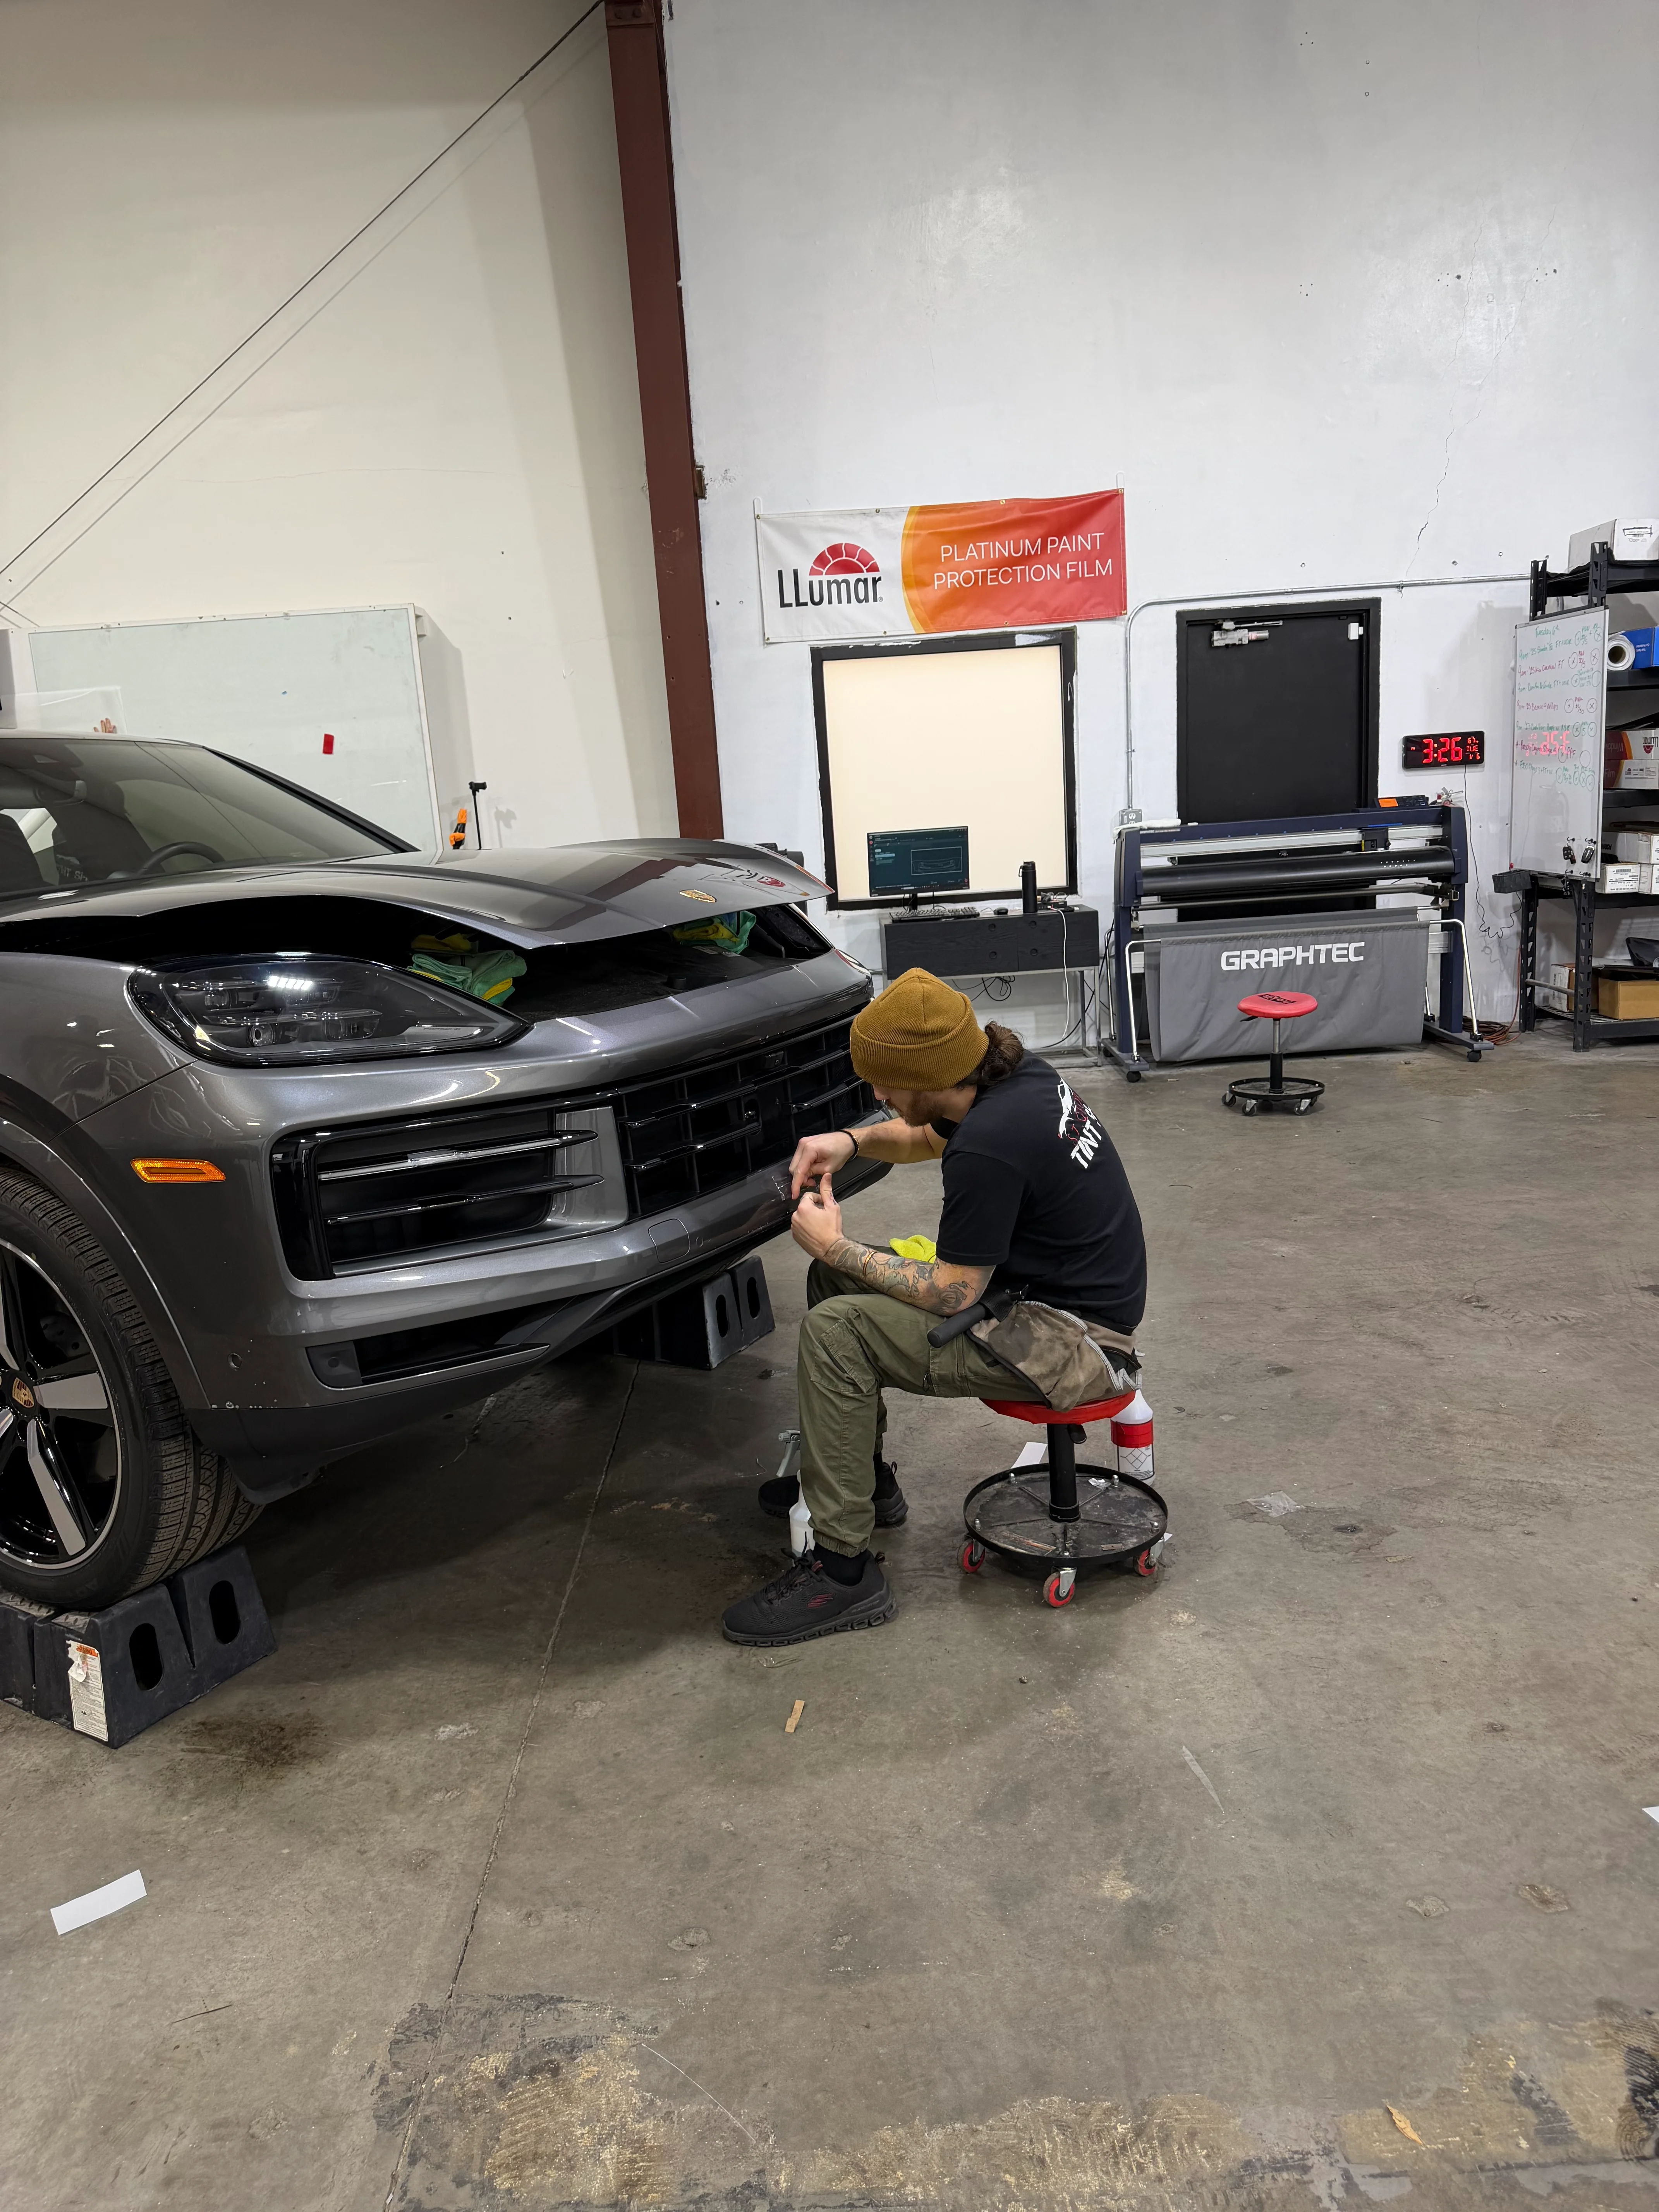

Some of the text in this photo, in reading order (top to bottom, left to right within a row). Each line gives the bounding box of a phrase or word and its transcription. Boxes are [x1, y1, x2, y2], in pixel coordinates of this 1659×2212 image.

[940, 532, 1105, 563] PLATINUM PAINT
[934, 559, 1113, 590] PROTECTION FILM
[1422, 737, 1463, 763] 3:26
[1567, 747, 1576, 759] PPF
[1605, 768, 1615, 778] Film
[1221, 941, 1365, 971] GRAPHTEC
